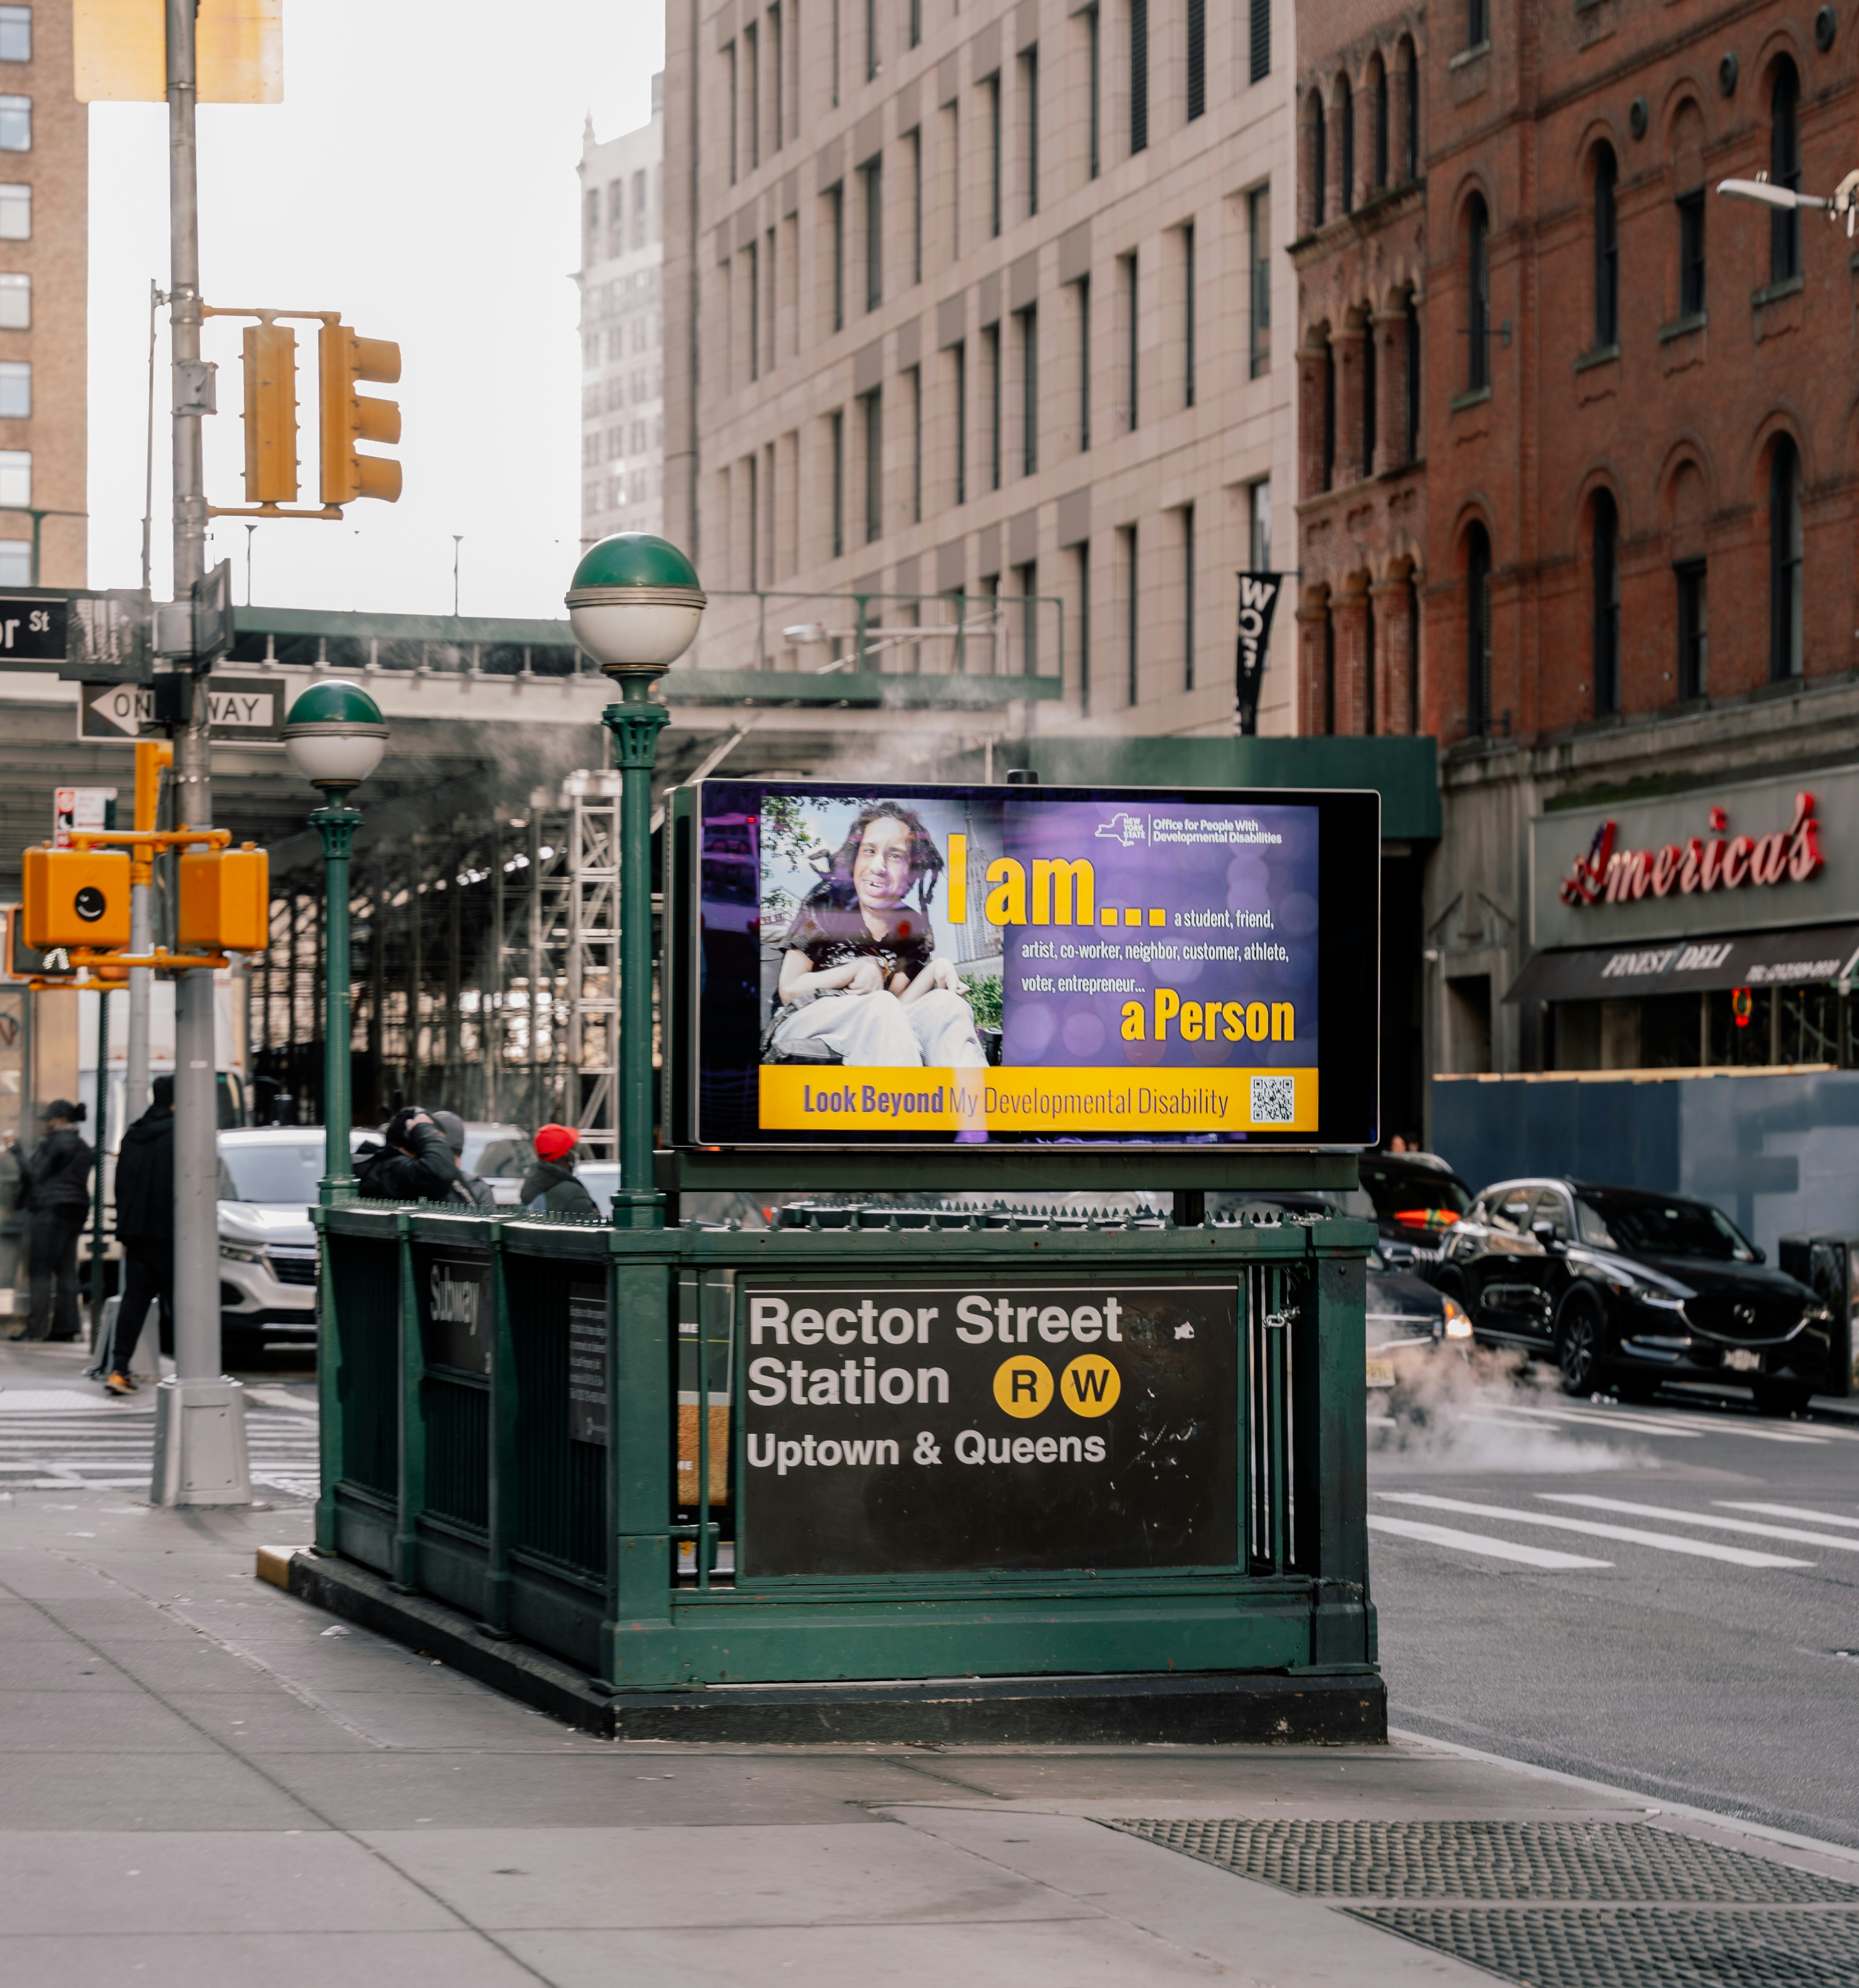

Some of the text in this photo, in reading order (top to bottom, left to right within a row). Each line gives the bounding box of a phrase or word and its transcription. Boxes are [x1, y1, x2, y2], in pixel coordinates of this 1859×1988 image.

[29, 610, 50, 632] St
[114, 693, 151, 718] ON
[1123, 831, 1146, 839] STATE
[1153, 818, 1259, 833] Office for People With
[1153, 831, 1282, 845] Developmental Disabilities
[1559, 792, 1824, 904] America's
[948, 834, 1166, 926] I am...
[1174, 908, 1274, 930] a student, friend,
[1022, 940, 1289, 963] artist, co-worker, neighbor, customer, athlete,
[1601, 943, 1734, 978] FINEST DELI
[1021, 974, 1146, 995] voter, entrepreneur...
[1120, 988, 1295, 1042] a Person
[804, 1085, 1229, 1119] Look Beyond My Developmental Disability
[750, 1295, 1123, 1345] Rector Street
[748, 1356, 1110, 1406] Station R W
[747, 1429, 1106, 1476] Uptown & Queens
